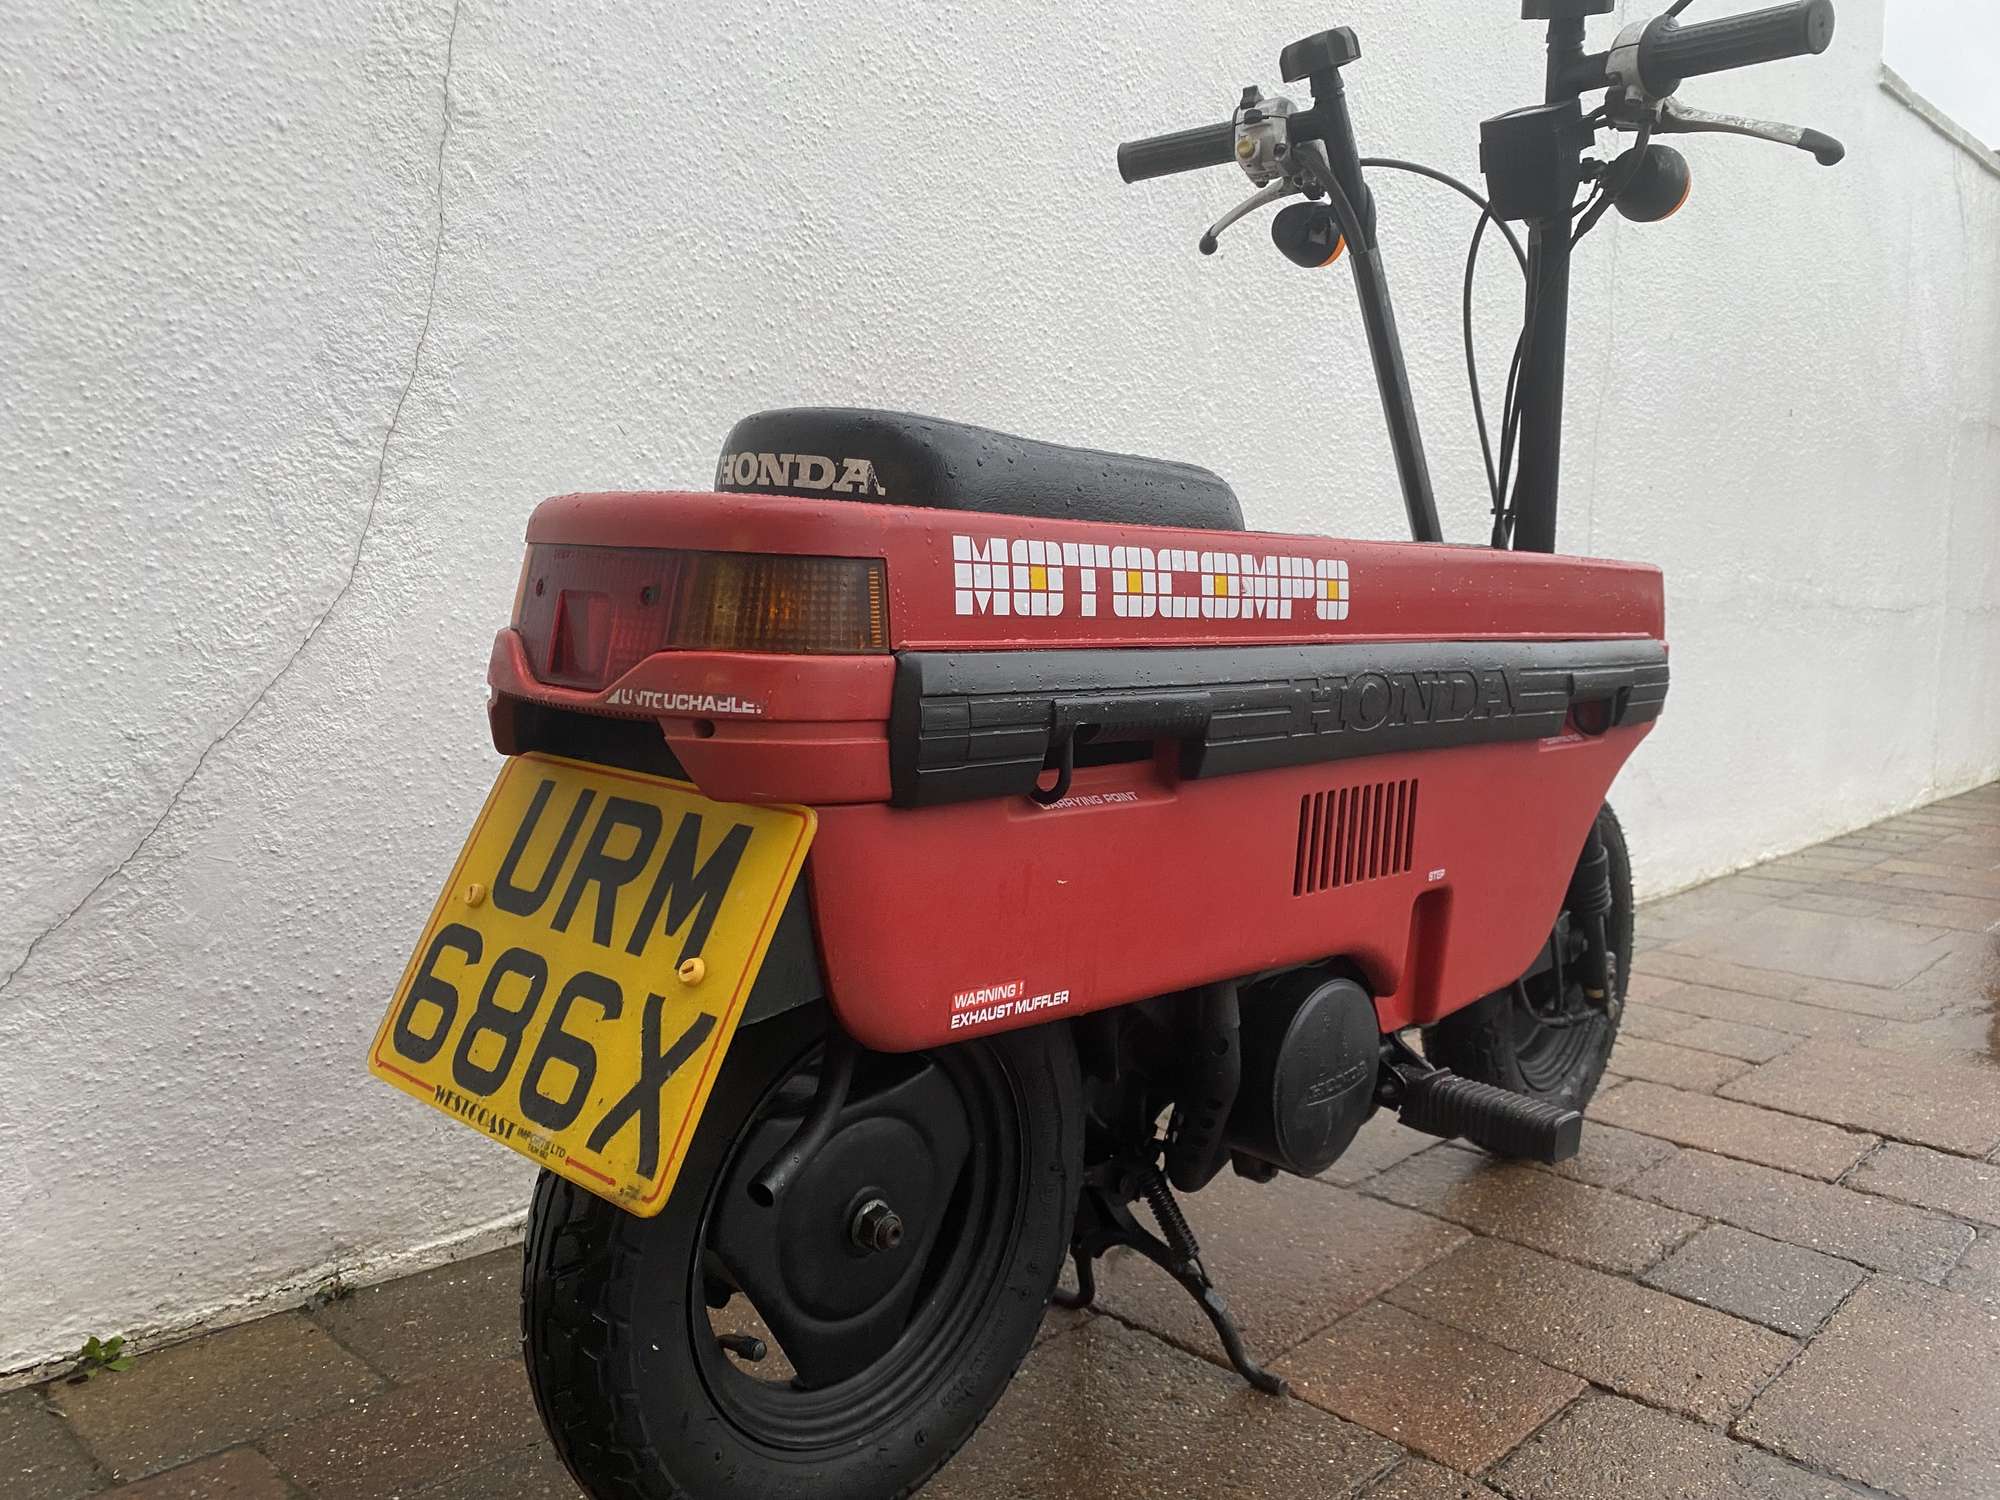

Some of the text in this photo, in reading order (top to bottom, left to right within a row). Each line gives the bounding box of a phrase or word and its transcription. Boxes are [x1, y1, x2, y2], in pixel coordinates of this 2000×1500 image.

[721, 451, 886, 496] HONDA
[952, 535, 1349, 620] MOTOCOMPO
[1291, 670, 1515, 737] HONDA
[1103, 791, 1138, 804] POINT
[492, 779, 755, 971] URM
[950, 990, 1070, 1030] EXHAUST MUFFLER
[954, 983, 1016, 1009] WARNING
[393, 922, 717, 1182] 686X
[434, 1084, 518, 1140] WESTCOAST
[550, 1143, 567, 1159] LTD
